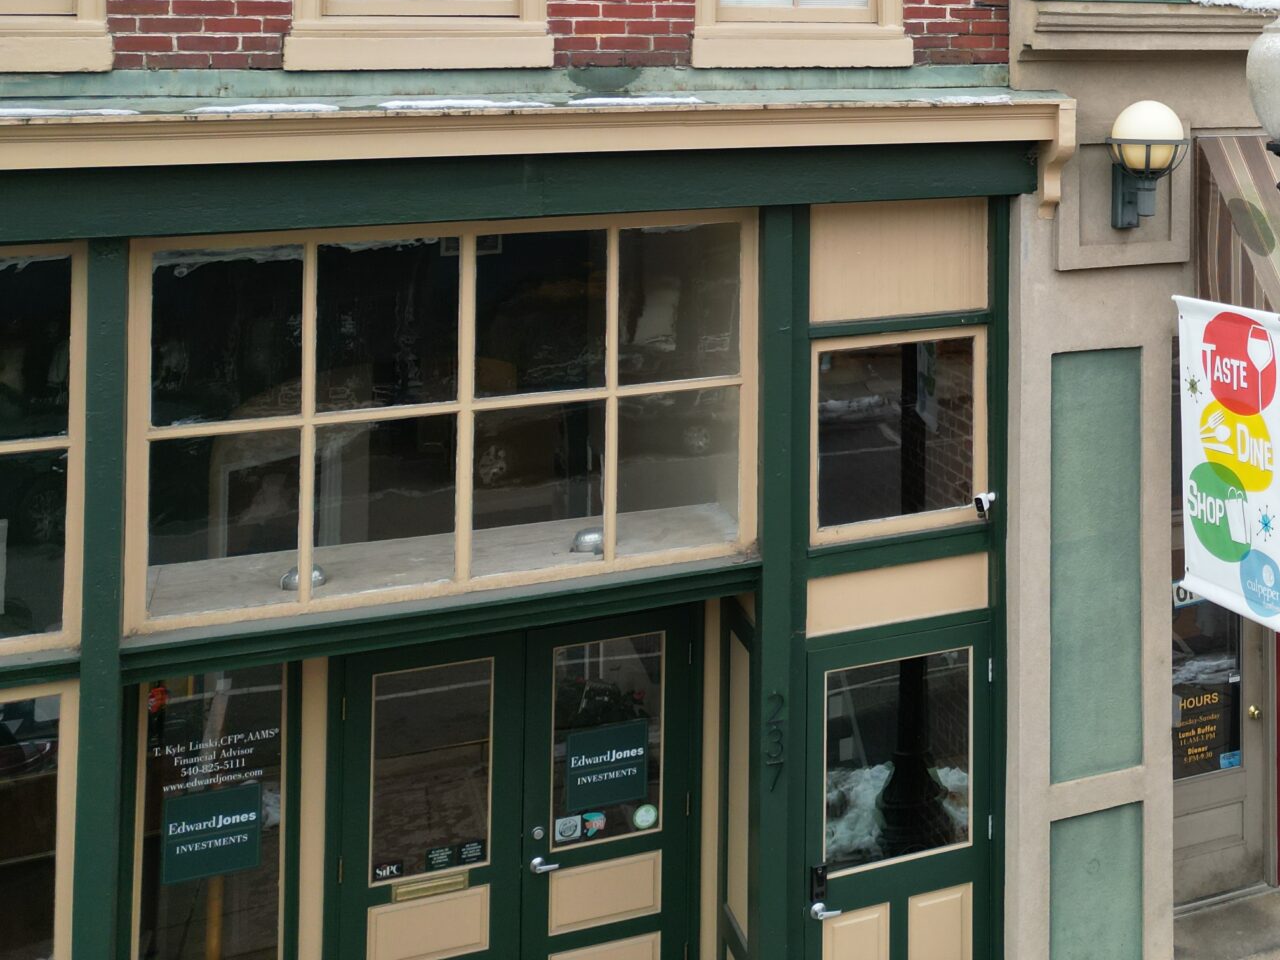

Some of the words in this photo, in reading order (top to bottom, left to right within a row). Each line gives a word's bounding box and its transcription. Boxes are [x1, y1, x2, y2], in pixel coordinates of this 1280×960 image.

[1201, 342, 1248, 390] TASTE
[1236, 423, 1274, 472] DINE
[1187, 480, 1225, 526] SHOP
[1247, 578, 1280, 603] culpeper
[1178, 692, 1219, 710] HOURS
[153, 746, 162, 757] T.
[165, 744, 186, 757] Kyle
[765, 692, 785, 792] 237
[174, 751, 216, 767] Financial
[220, 746, 254, 759] Advisor
[180, 757, 246, 778] 540-825-5111
[570, 750, 610, 769] Edward
[610, 746, 644, 762] Jones
[162, 768, 263, 793] www.edwardjones.com
[577, 767, 637, 786] INVESTMENTS
[168, 816, 216, 836] Edward
[216, 811, 257, 828] Jones
[176, 833, 248, 855] INVESTMENTS
